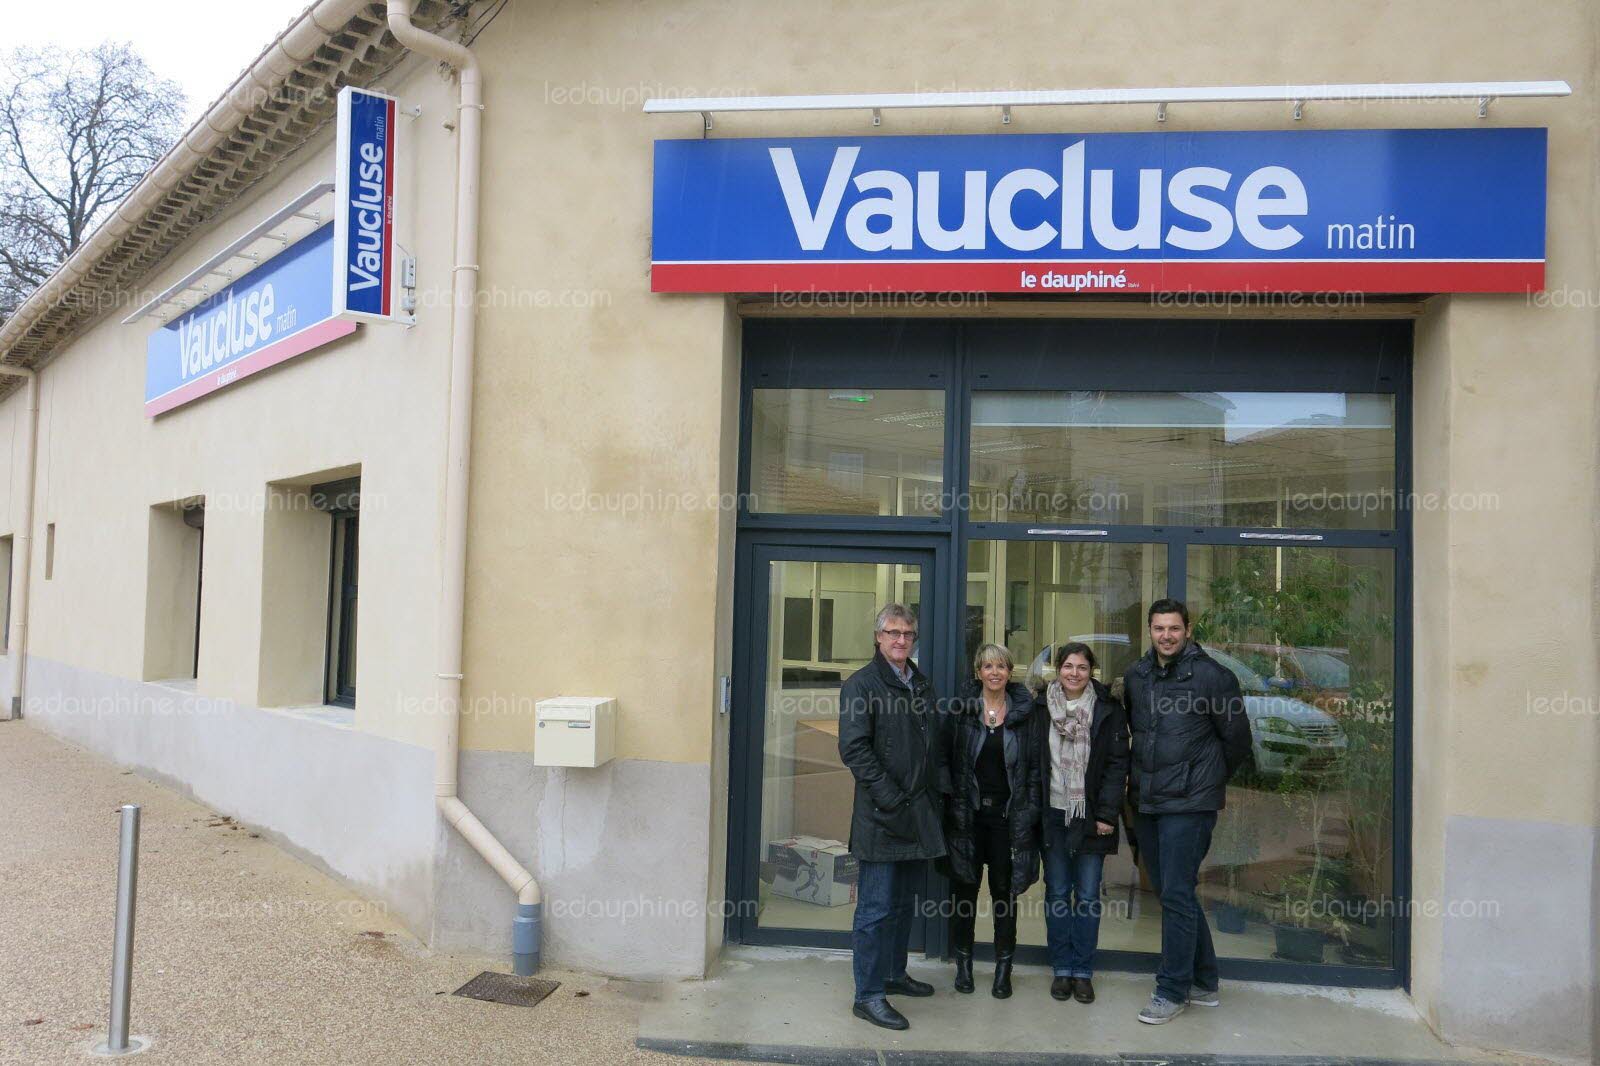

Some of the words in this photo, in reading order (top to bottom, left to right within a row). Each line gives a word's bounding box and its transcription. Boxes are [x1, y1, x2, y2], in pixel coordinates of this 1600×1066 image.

[350, 142, 383, 291] Vaucluse
[375, 115, 385, 141] matin
[768, 139, 1308, 252] Vaucluse
[1327, 215, 1415, 249] matin
[179, 283, 274, 379] Vaucluse
[276, 305, 297, 334] matin
[1021, 270, 1037, 288] le
[1041, 269, 1126, 291] dauphiné
